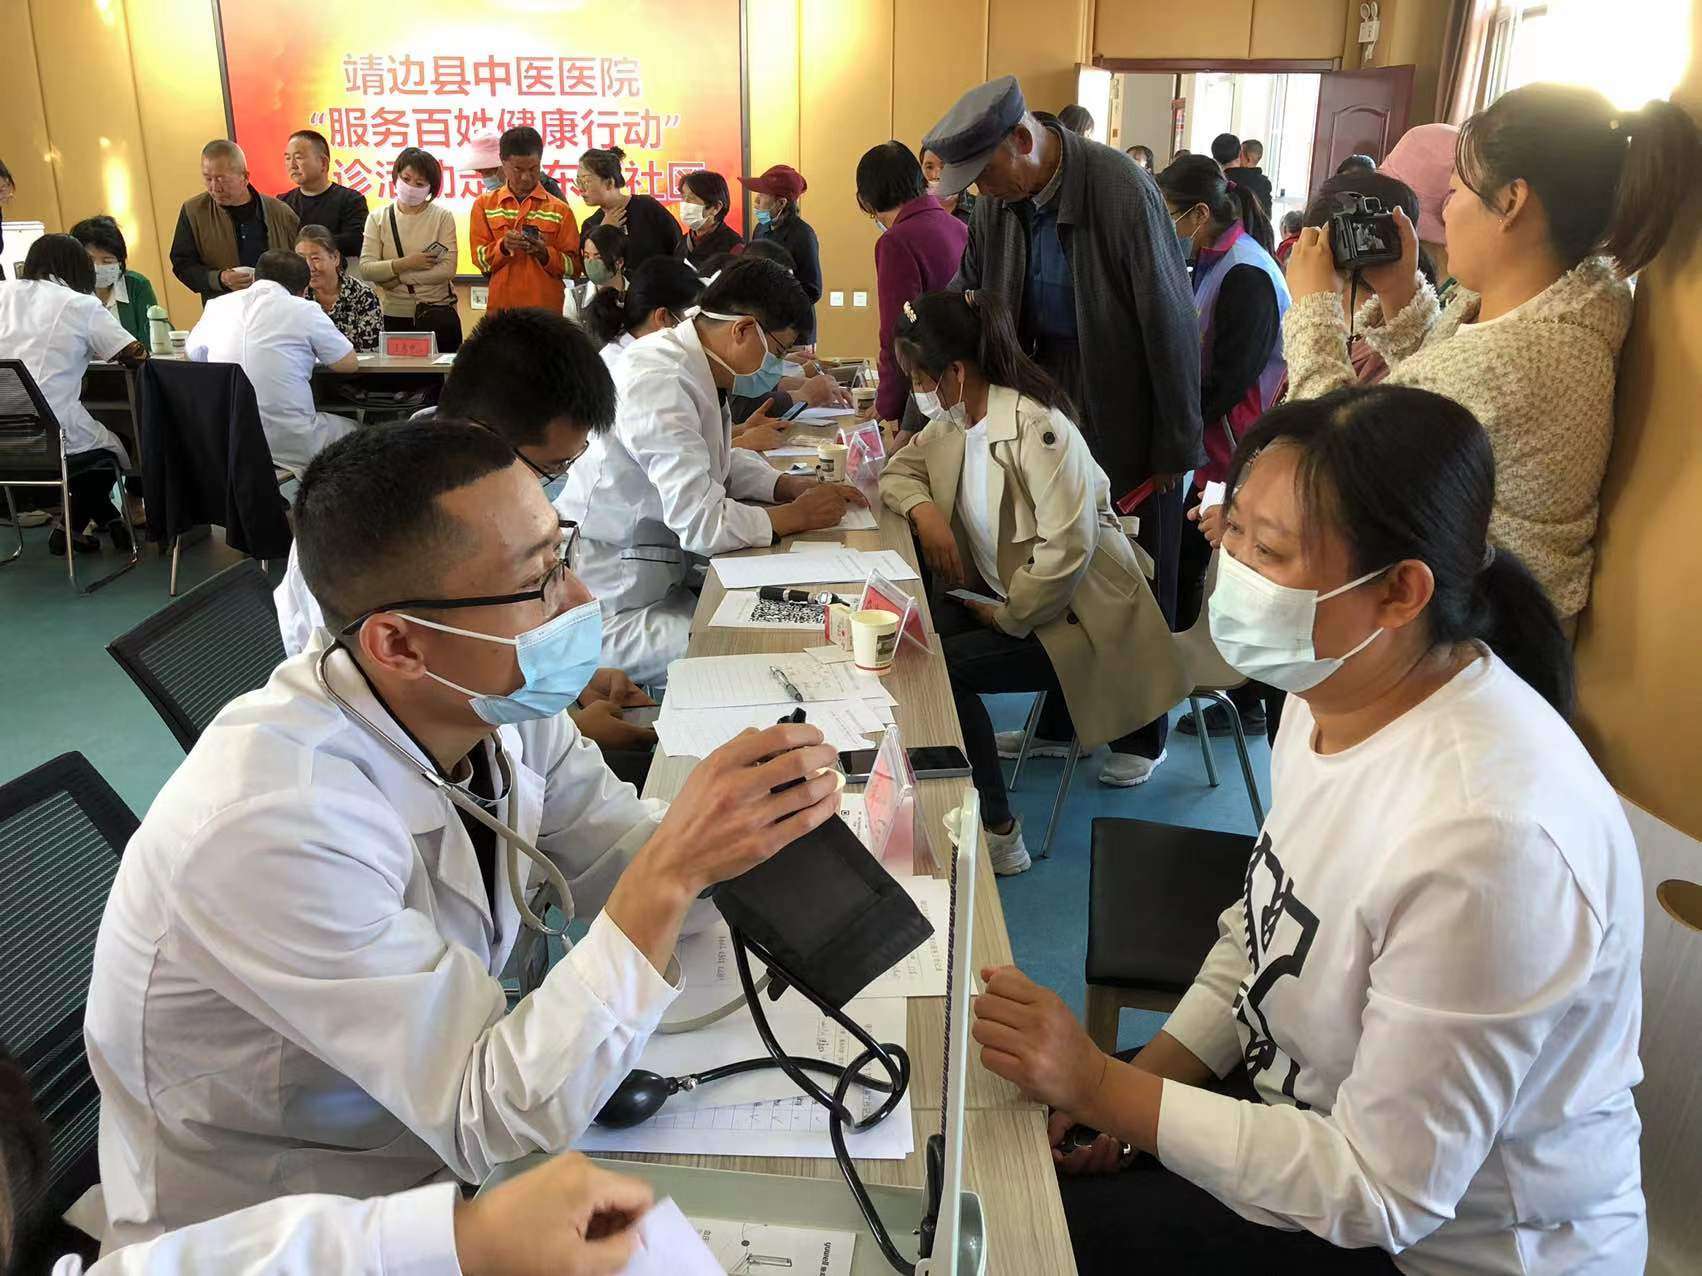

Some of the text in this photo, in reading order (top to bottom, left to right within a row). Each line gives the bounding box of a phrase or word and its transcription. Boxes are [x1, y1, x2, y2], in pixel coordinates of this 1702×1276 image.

[343, 54, 640, 98] 靖边县中医医院
